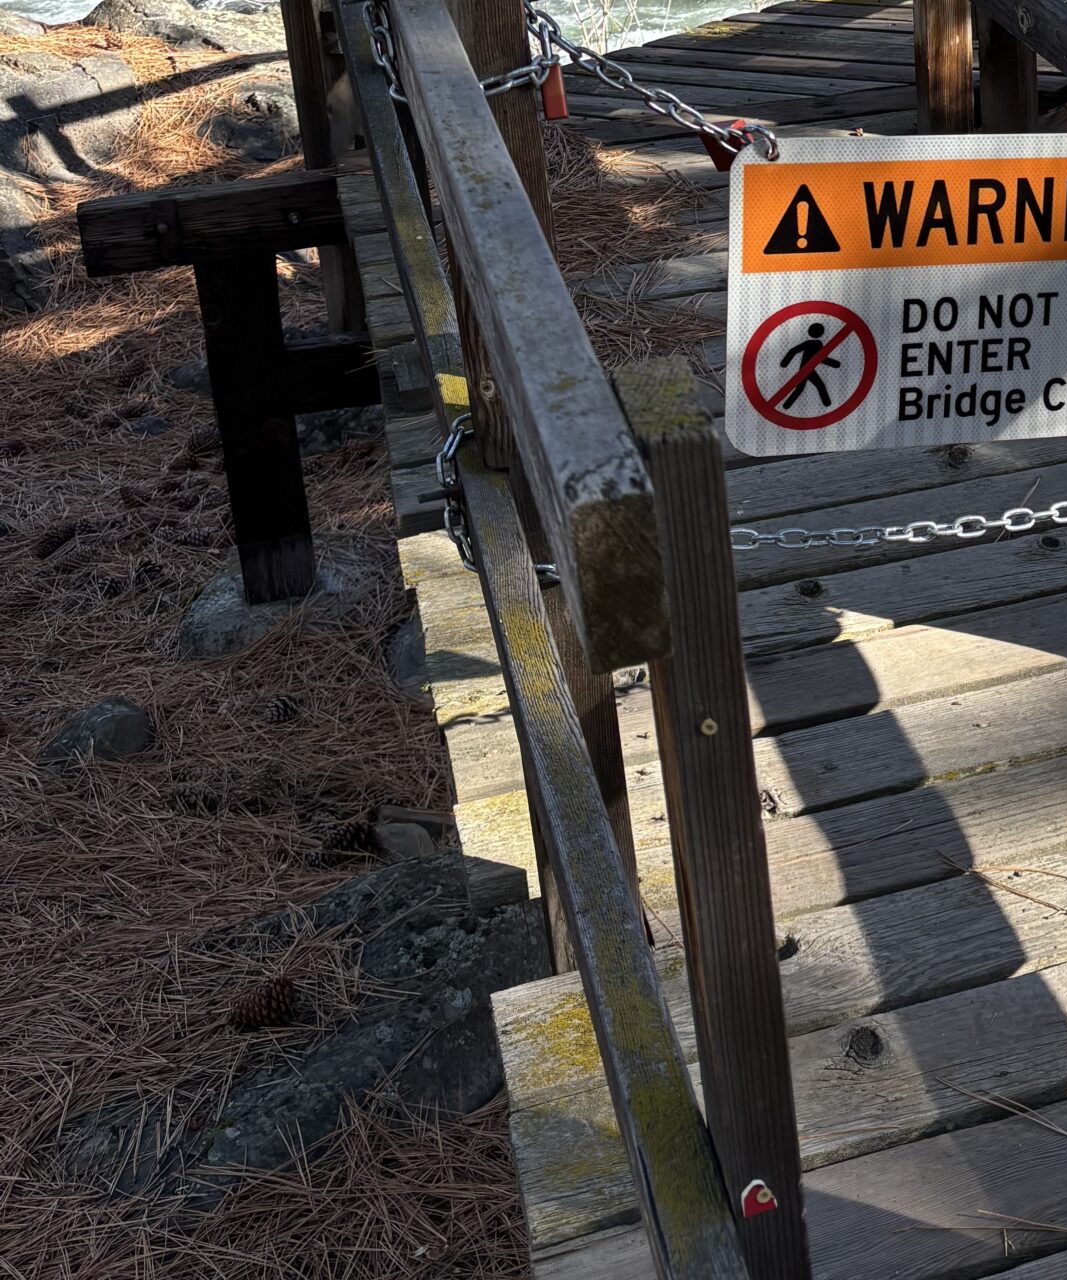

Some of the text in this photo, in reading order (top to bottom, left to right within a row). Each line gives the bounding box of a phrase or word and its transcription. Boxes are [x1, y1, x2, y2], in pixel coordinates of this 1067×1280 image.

[901, 291, 1060, 334] DO NOT
[900, 336, 1032, 378] ENTER
[898, 382, 1026, 427] Bridge
